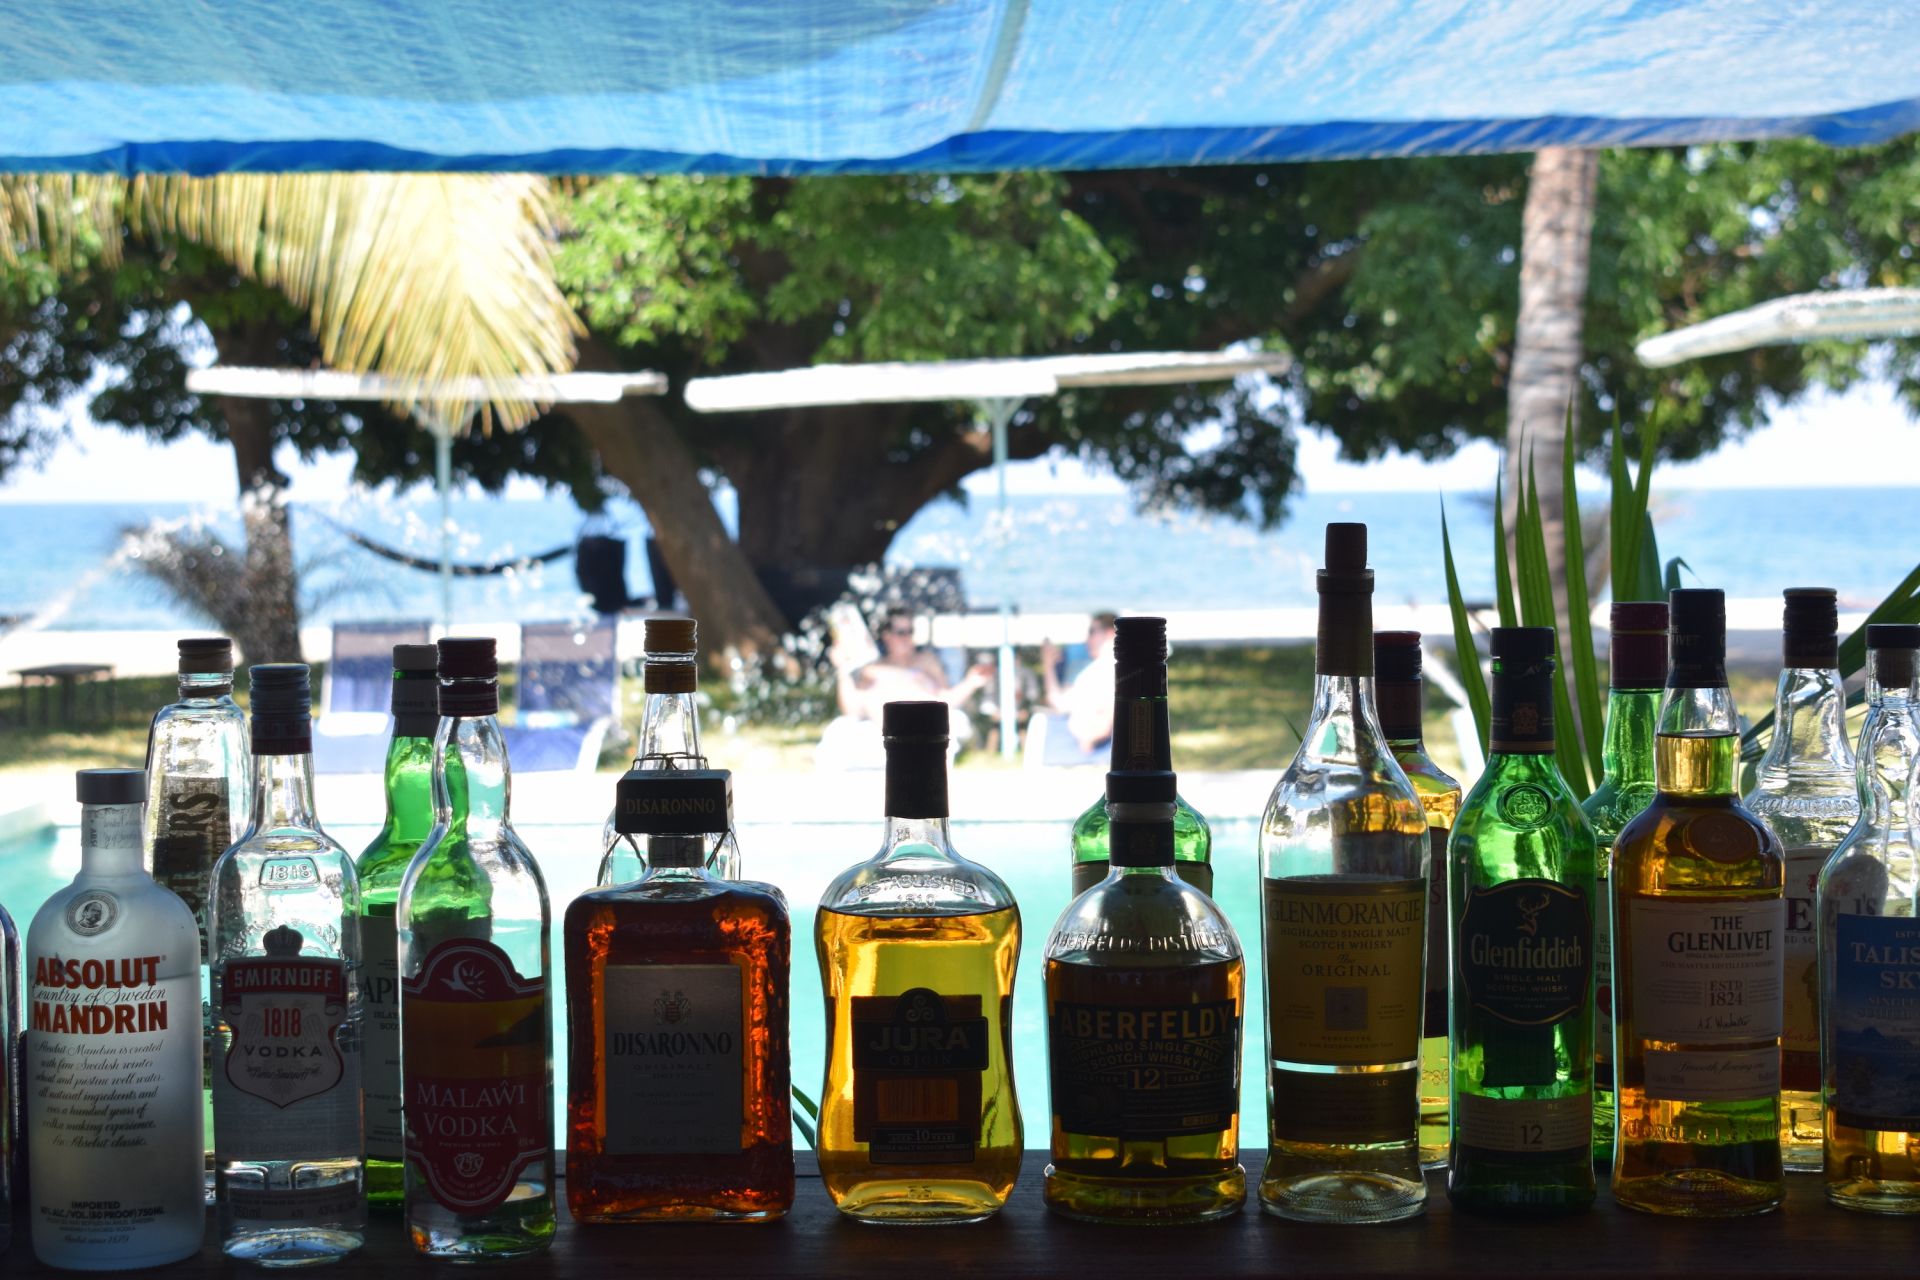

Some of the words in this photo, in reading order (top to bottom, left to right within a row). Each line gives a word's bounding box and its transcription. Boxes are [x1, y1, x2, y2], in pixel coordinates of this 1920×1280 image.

[625, 798, 717, 816] DISARONNO
[269, 863, 312, 881] 1818
[859, 874, 978, 898] ESTABLISHED
[1270, 898, 1421, 925] GLENMORANGIE
[1280, 926, 1338, 938] HIGHLAND
[1341, 929, 1383, 938] SINGLE
[1386, 927, 1411, 937] MALT
[1709, 915, 1743, 930] THE
[1298, 940, 1345, 949] SCOTCH
[1349, 940, 1393, 949] WHISKY
[1471, 934, 1582, 969] Glenfiddich
[1667, 930, 1773, 953] GLENLIVET
[34, 956, 161, 989] ABSOLUT
[233, 968, 334, 989] SMIRNOFF
[1301, 963, 1392, 977] ORIGINAL
[1490, 974, 1532, 982] SINGLE
[1536, 974, 1561, 982] MALT
[32, 981, 81, 1012] Country
[84, 986, 105, 1012] of
[103, 983, 167, 1006] Sweden
[1485, 984, 1526, 992] SCOTCH
[1531, 984, 1569, 993] WHISKY
[1709, 992, 1744, 1007] 1824
[33, 1001, 168, 1035] MANDRIN
[264, 1007, 301, 1038] 1818
[1060, 1006, 1232, 1041] ABERFELDY
[613, 1031, 733, 1058] DISARONNO
[869, 1025, 971, 1052] JURA
[243, 1046, 324, 1058] VODKA
[888, 1055, 953, 1070] ORIGIN
[1070, 1040, 1135, 1065] HIGHLAND
[1139, 1040, 1191, 1051] SINGLE
[1193, 1046, 1220, 1064] MALT
[1089, 1053, 1144, 1071] SCOTCH
[1148, 1052, 1202, 1069] WHISKY
[1132, 1067, 1162, 1090] 12
[423, 1112, 519, 1137] VODKA
[915, 1128, 930, 1141] 10
[1520, 1123, 1545, 1145] 12
[71, 1200, 121, 1210] IMPORTED
